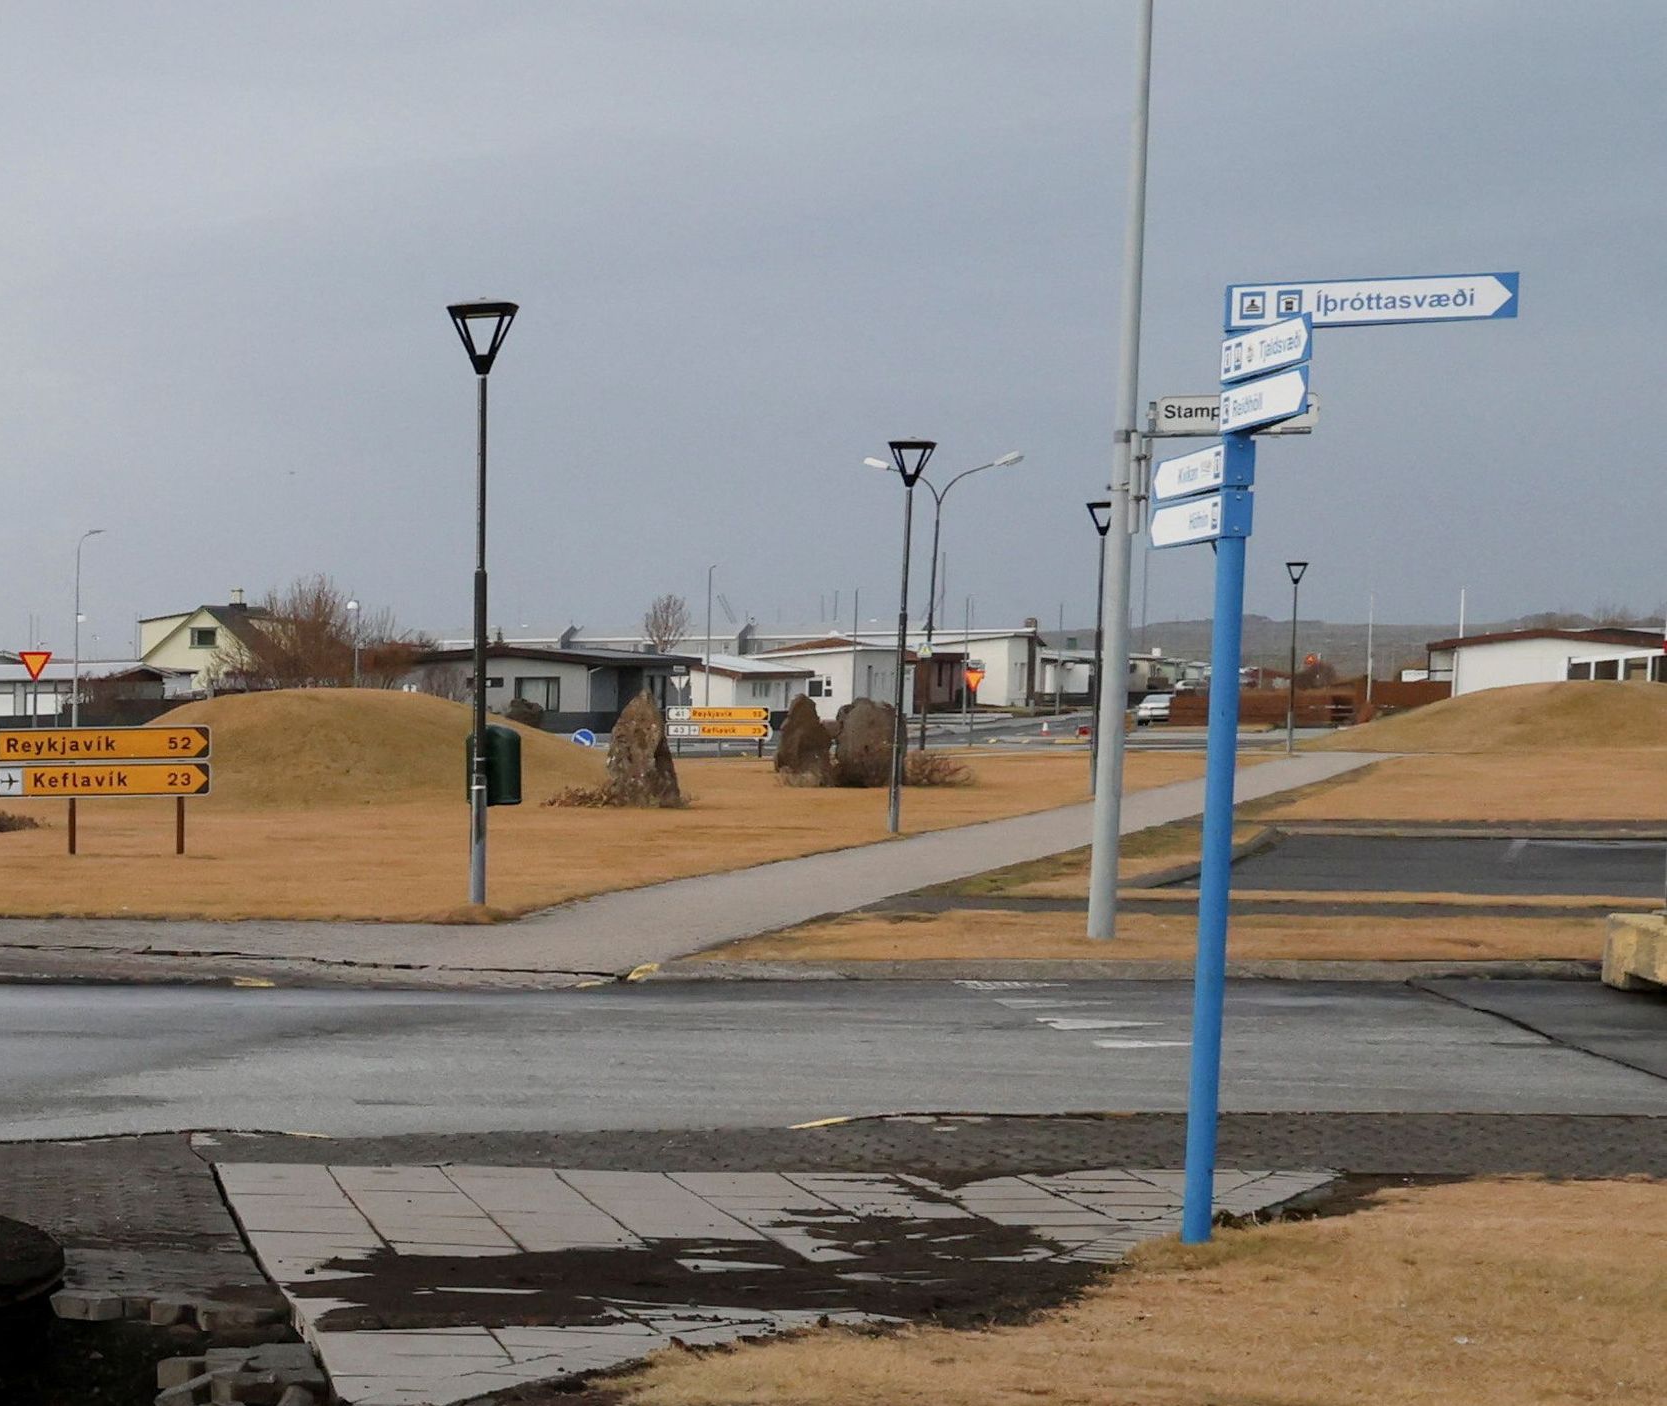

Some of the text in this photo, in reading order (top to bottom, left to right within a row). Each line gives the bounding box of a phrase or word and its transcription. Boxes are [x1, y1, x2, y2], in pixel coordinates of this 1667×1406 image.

[1315, 288, 1475, 317] Íþróttasvæði
[6, 738, 116, 755] Reykjavík
[168, 737, 192, 750] 52
[33, 772, 128, 788] Keflavík
[167, 773, 192, 786] 23
